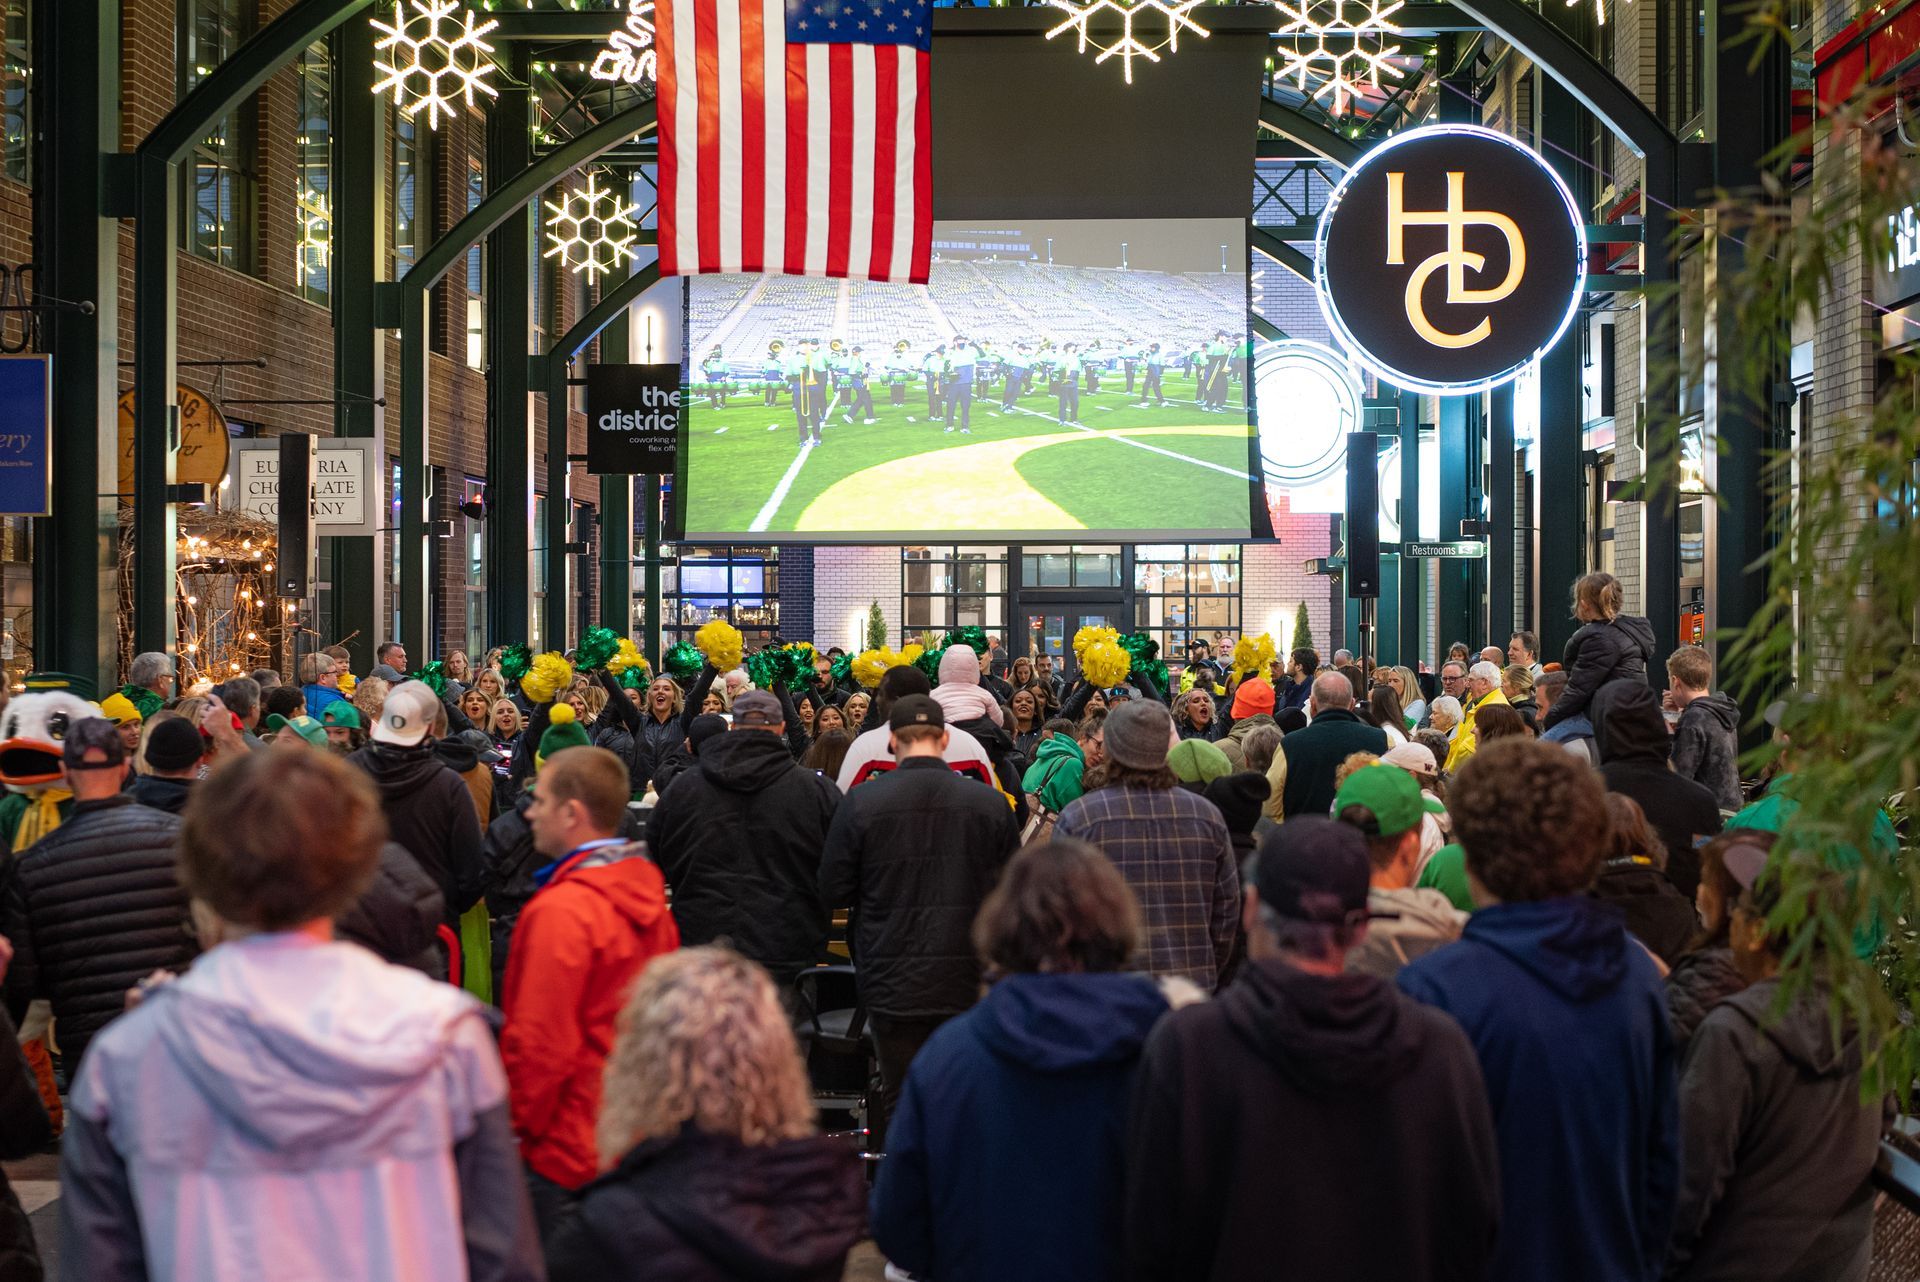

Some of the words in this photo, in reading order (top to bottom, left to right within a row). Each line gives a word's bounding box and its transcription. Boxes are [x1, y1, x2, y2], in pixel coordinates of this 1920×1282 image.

[642, 386, 681, 407] the
[629, 436, 669, 444] coworking
[256, 460, 348, 473] EURIA
[1412, 545, 1456, 556] Restrooms
[1424, 763, 1433, 772] W
